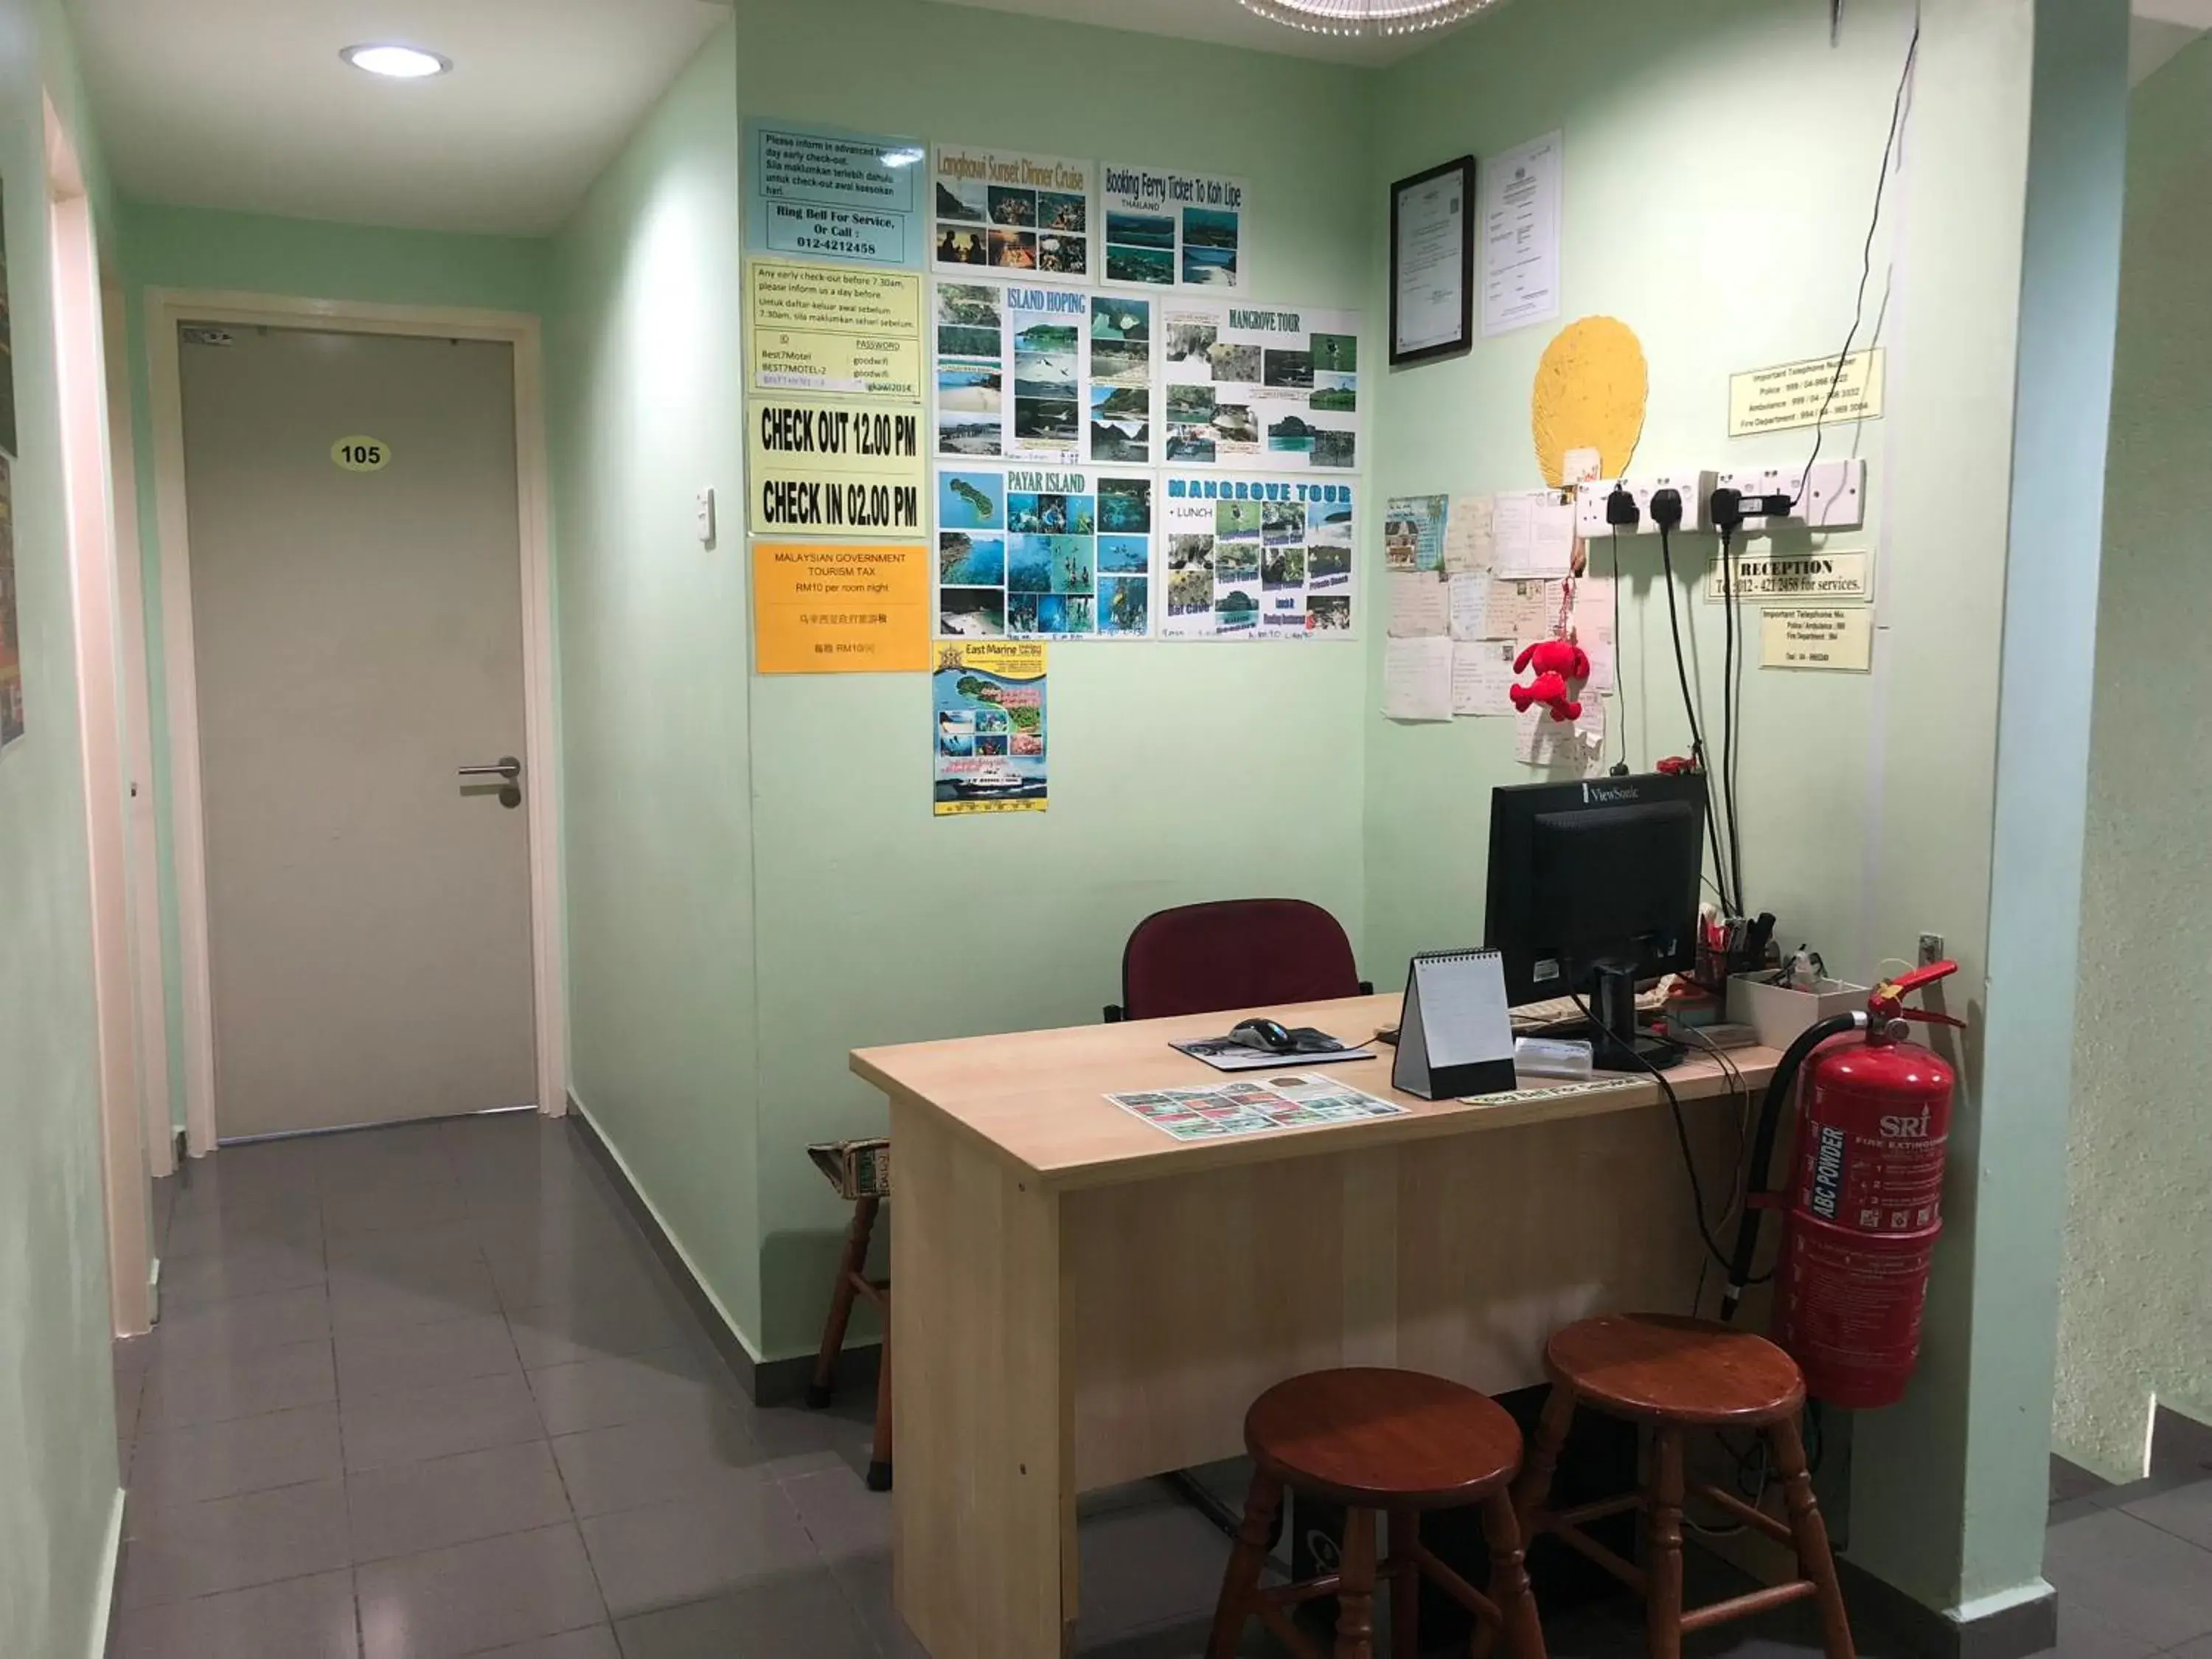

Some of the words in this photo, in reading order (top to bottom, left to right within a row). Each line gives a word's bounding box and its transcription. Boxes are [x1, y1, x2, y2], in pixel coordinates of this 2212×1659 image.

[766, 134, 793, 145] Please
[796, 139, 824, 150] inform
[766, 147, 781, 159] day
[783, 150, 804, 162] early
[785, 163, 832, 175] maklumkan
[834, 168, 863, 179] terlebih
[937, 147, 987, 181] Langkawi
[989, 154, 1020, 184] Sunset
[1021, 158, 1054, 188] Dinner
[1055, 161, 1084, 190] Cruise
[766, 174, 790, 184] untuk
[1107, 168, 1139, 200] Booking
[1142, 172, 1166, 203] Ferry
[1168, 175, 1194, 201] Ticket
[1196, 178, 1205, 202] To
[1207, 181, 1222, 204] Koh
[1225, 182, 1241, 209] Lipe
[1121, 199, 1160, 212] THAILAND
[777, 206, 803, 220] Ring
[806, 207, 828, 220] Bell
[831, 210, 849, 222] For
[852, 212, 895, 229] Service,
[814, 223, 828, 234] Or
[831, 225, 852, 237] Call
[797, 237, 876, 254] 012-4212458
[759, 269, 775, 279] Any
[777, 271, 799, 281] early
[844, 274, 870, 285] before
[759, 283, 787, 291] please
[788, 283, 817, 293] inform
[837, 288, 852, 298] day
[759, 298, 784, 307] Untuk
[812, 301, 837, 310] keluar
[858, 305, 891, 315] sebelum
[1007, 287, 1044, 310] ISLAND
[1046, 291, 1085, 313] HOPING
[1229, 309, 1276, 331] MANGROVE
[1277, 313, 1301, 333] TOUR
[855, 339, 900, 352] PASSWORD
[1753, 369, 1787, 383] Important
[1788, 364, 1825, 376] Telephone
[1759, 386, 1781, 396] Police
[1749, 400, 1787, 412] Ambulance
[1739, 418, 1753, 428] Fire
[1754, 413, 1796, 426] Department
[762, 406, 815, 452] CHECK
[818, 410, 849, 454] OUT
[853, 412, 891, 456] 12.00
[894, 415, 917, 456] PM
[341, 445, 381, 465] 105
[1008, 471, 1043, 492] PAYAR
[1045, 472, 1085, 493] ISLAND
[1167, 479, 1291, 501] MANGROVE
[1295, 484, 1352, 503] TOUR
[762, 480, 822, 525] CHECK
[825, 483, 843, 525] IN
[847, 484, 889, 527] 02.00
[894, 486, 917, 527] PM
[1177, 507, 1214, 518] LUNCH
[775, 553, 834, 563] MALAYSIAN
[835, 554, 906, 563] GOVERNMENT
[807, 567, 855, 577] TOURISM
[857, 567, 876, 576] TAX
[1741, 559, 1834, 577] RECEPTION
[795, 582, 824, 593] RM10
[825, 584, 839, 595] per
[841, 585, 865, 593] room
[866, 583, 889, 594] night
[1801, 577, 1816, 591] for
[1817, 576, 1862, 591] services.
[1762, 610, 1795, 619] Important
[966, 644, 986, 655] East
[987, 644, 1017, 655] Marine
[1590, 785, 1640, 802] ViewSonic
[1816, 1127, 1845, 1187] POWDER
[1813, 1186, 1836, 1218] ABC
